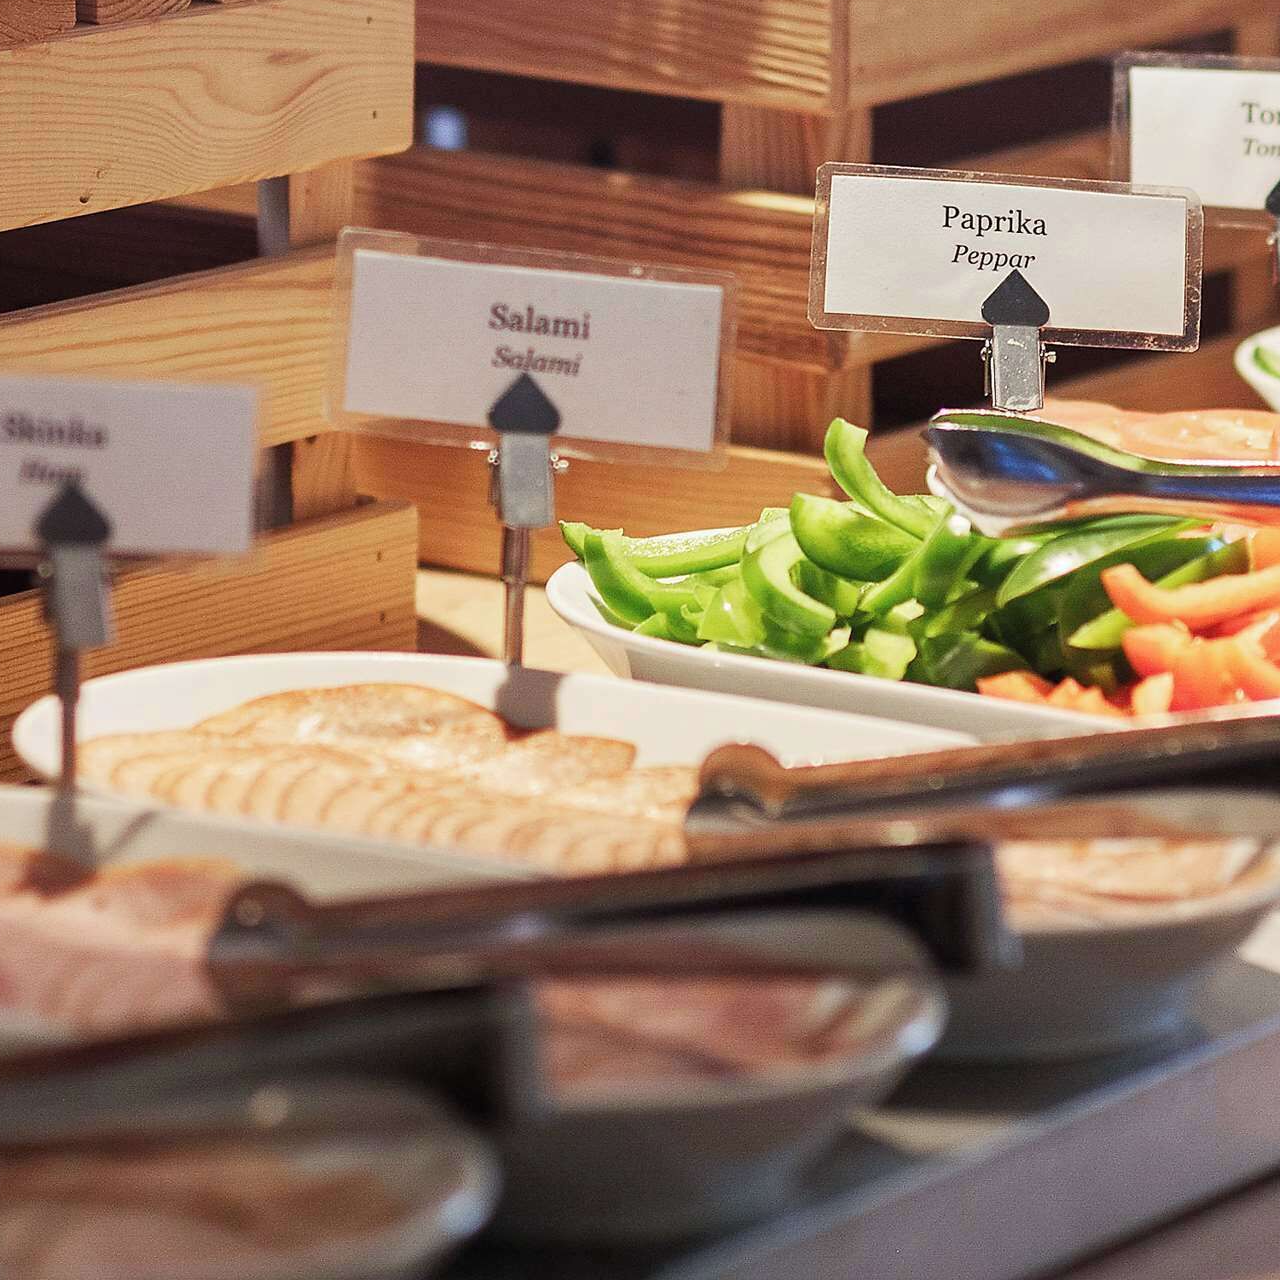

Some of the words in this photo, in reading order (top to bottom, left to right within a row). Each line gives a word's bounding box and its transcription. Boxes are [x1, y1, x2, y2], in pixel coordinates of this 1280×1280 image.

[942, 205, 1047, 237] Paprika
[951, 244, 1036, 271] Peppar
[488, 303, 591, 339] Salami
[491, 345, 583, 376] Salami
